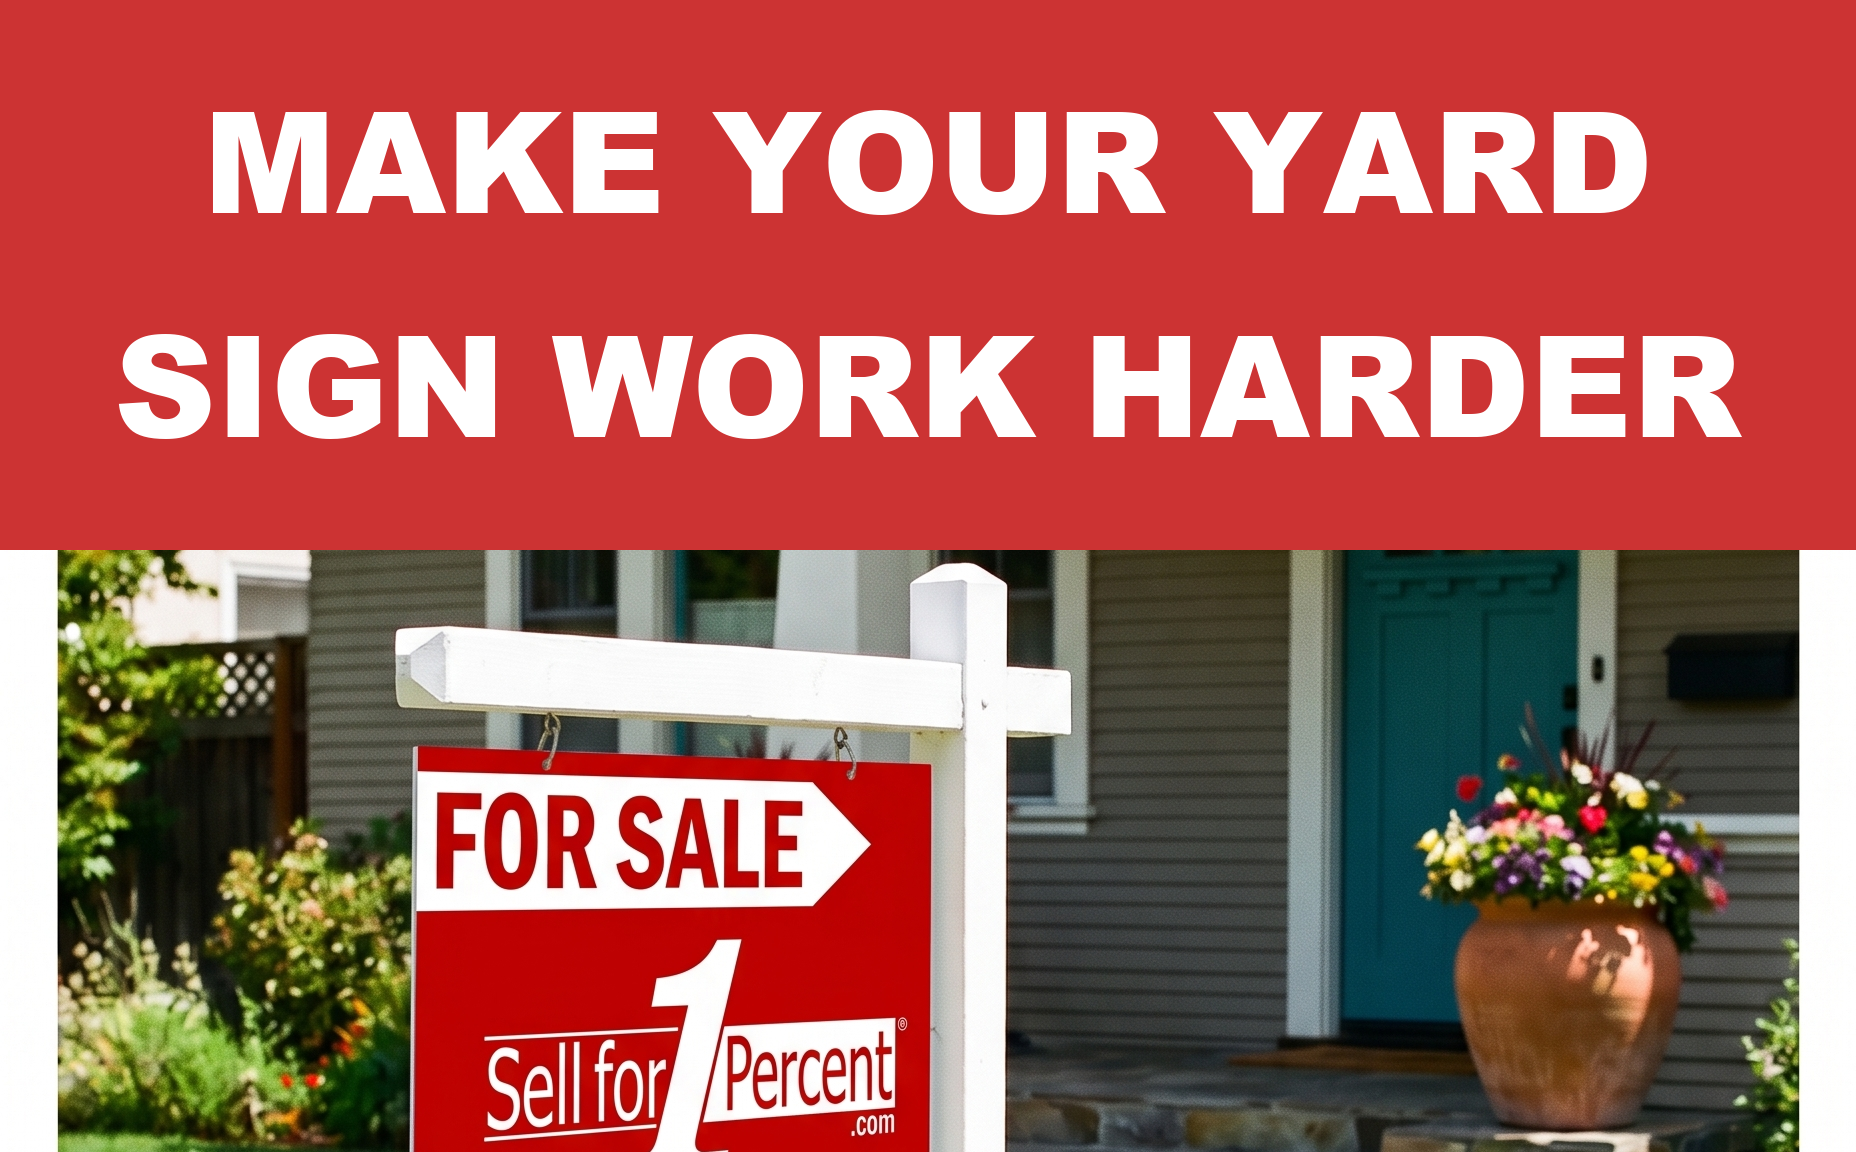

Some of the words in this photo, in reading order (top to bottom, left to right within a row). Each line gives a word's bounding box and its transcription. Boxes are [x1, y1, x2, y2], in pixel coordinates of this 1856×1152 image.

[435, 791, 598, 891] FOR
[615, 794, 803, 891] SALE
[486, 1041, 581, 1131] Sell
[594, 1039, 667, 1124] for
[726, 1030, 894, 1112] Percent
[850, 1111, 896, 1137] .com
